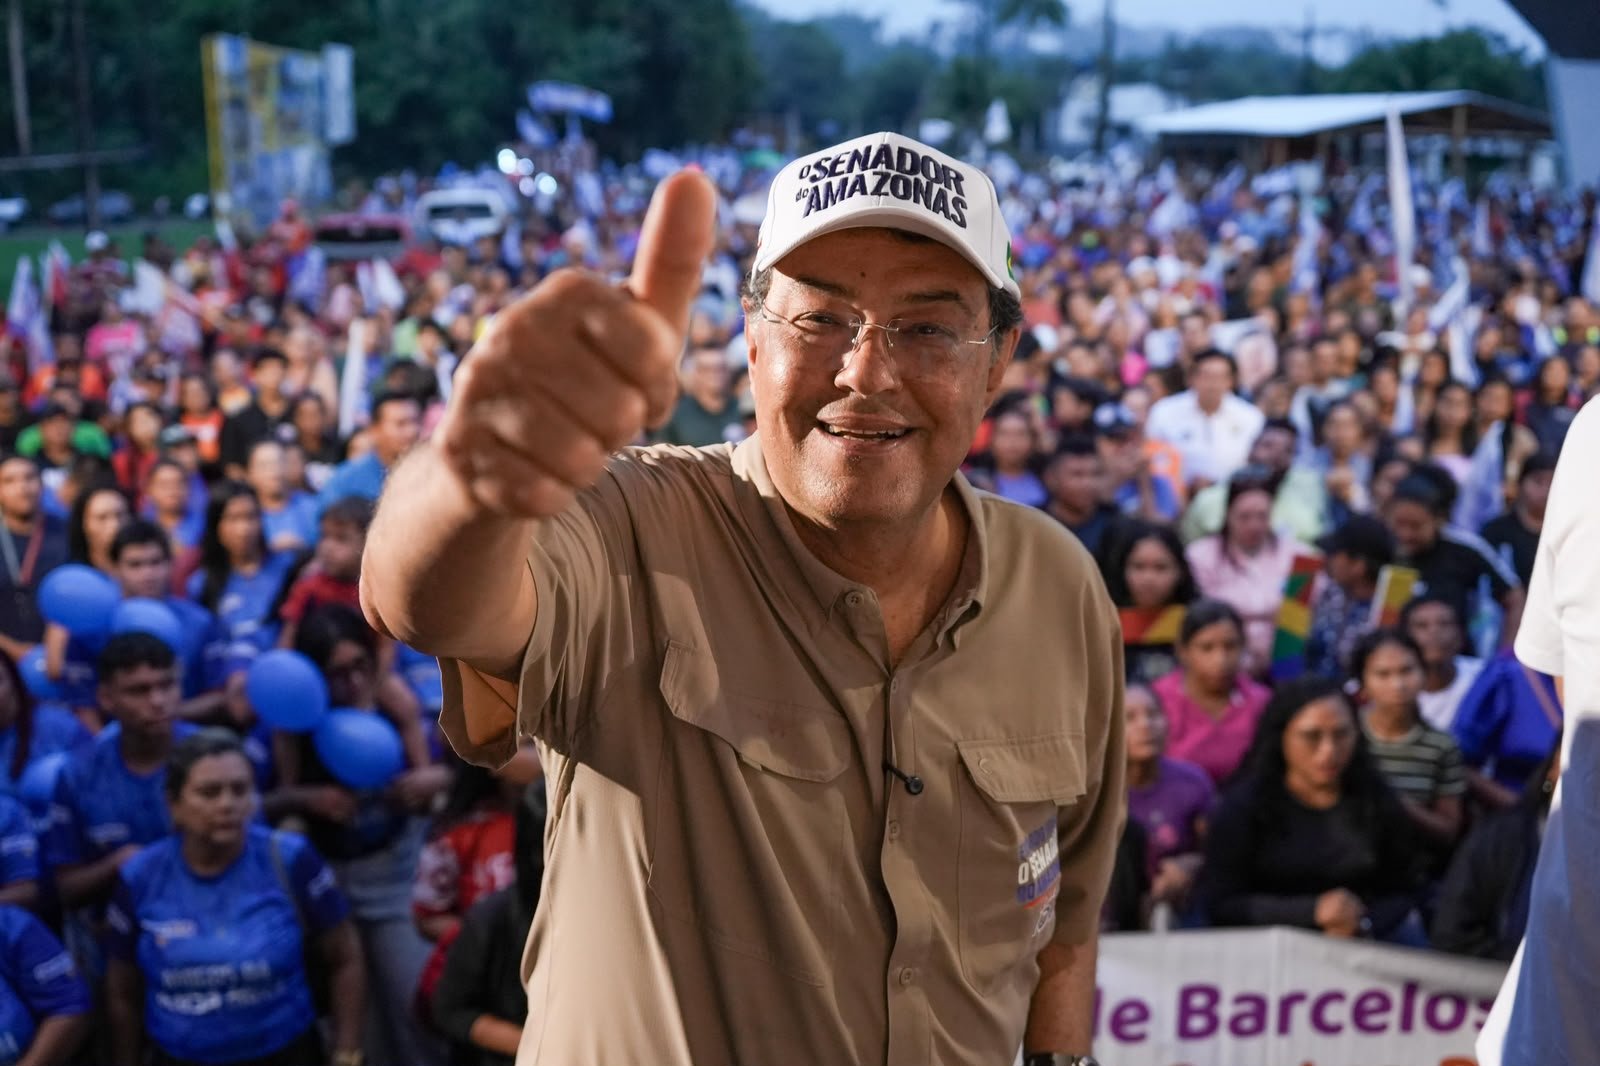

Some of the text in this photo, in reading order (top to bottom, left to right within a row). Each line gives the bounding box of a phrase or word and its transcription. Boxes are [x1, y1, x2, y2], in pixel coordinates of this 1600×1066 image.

[799, 143, 966, 197] O SENADOR
[796, 170, 968, 229] do AMAZONAS
[1018, 862, 1030, 885] O
